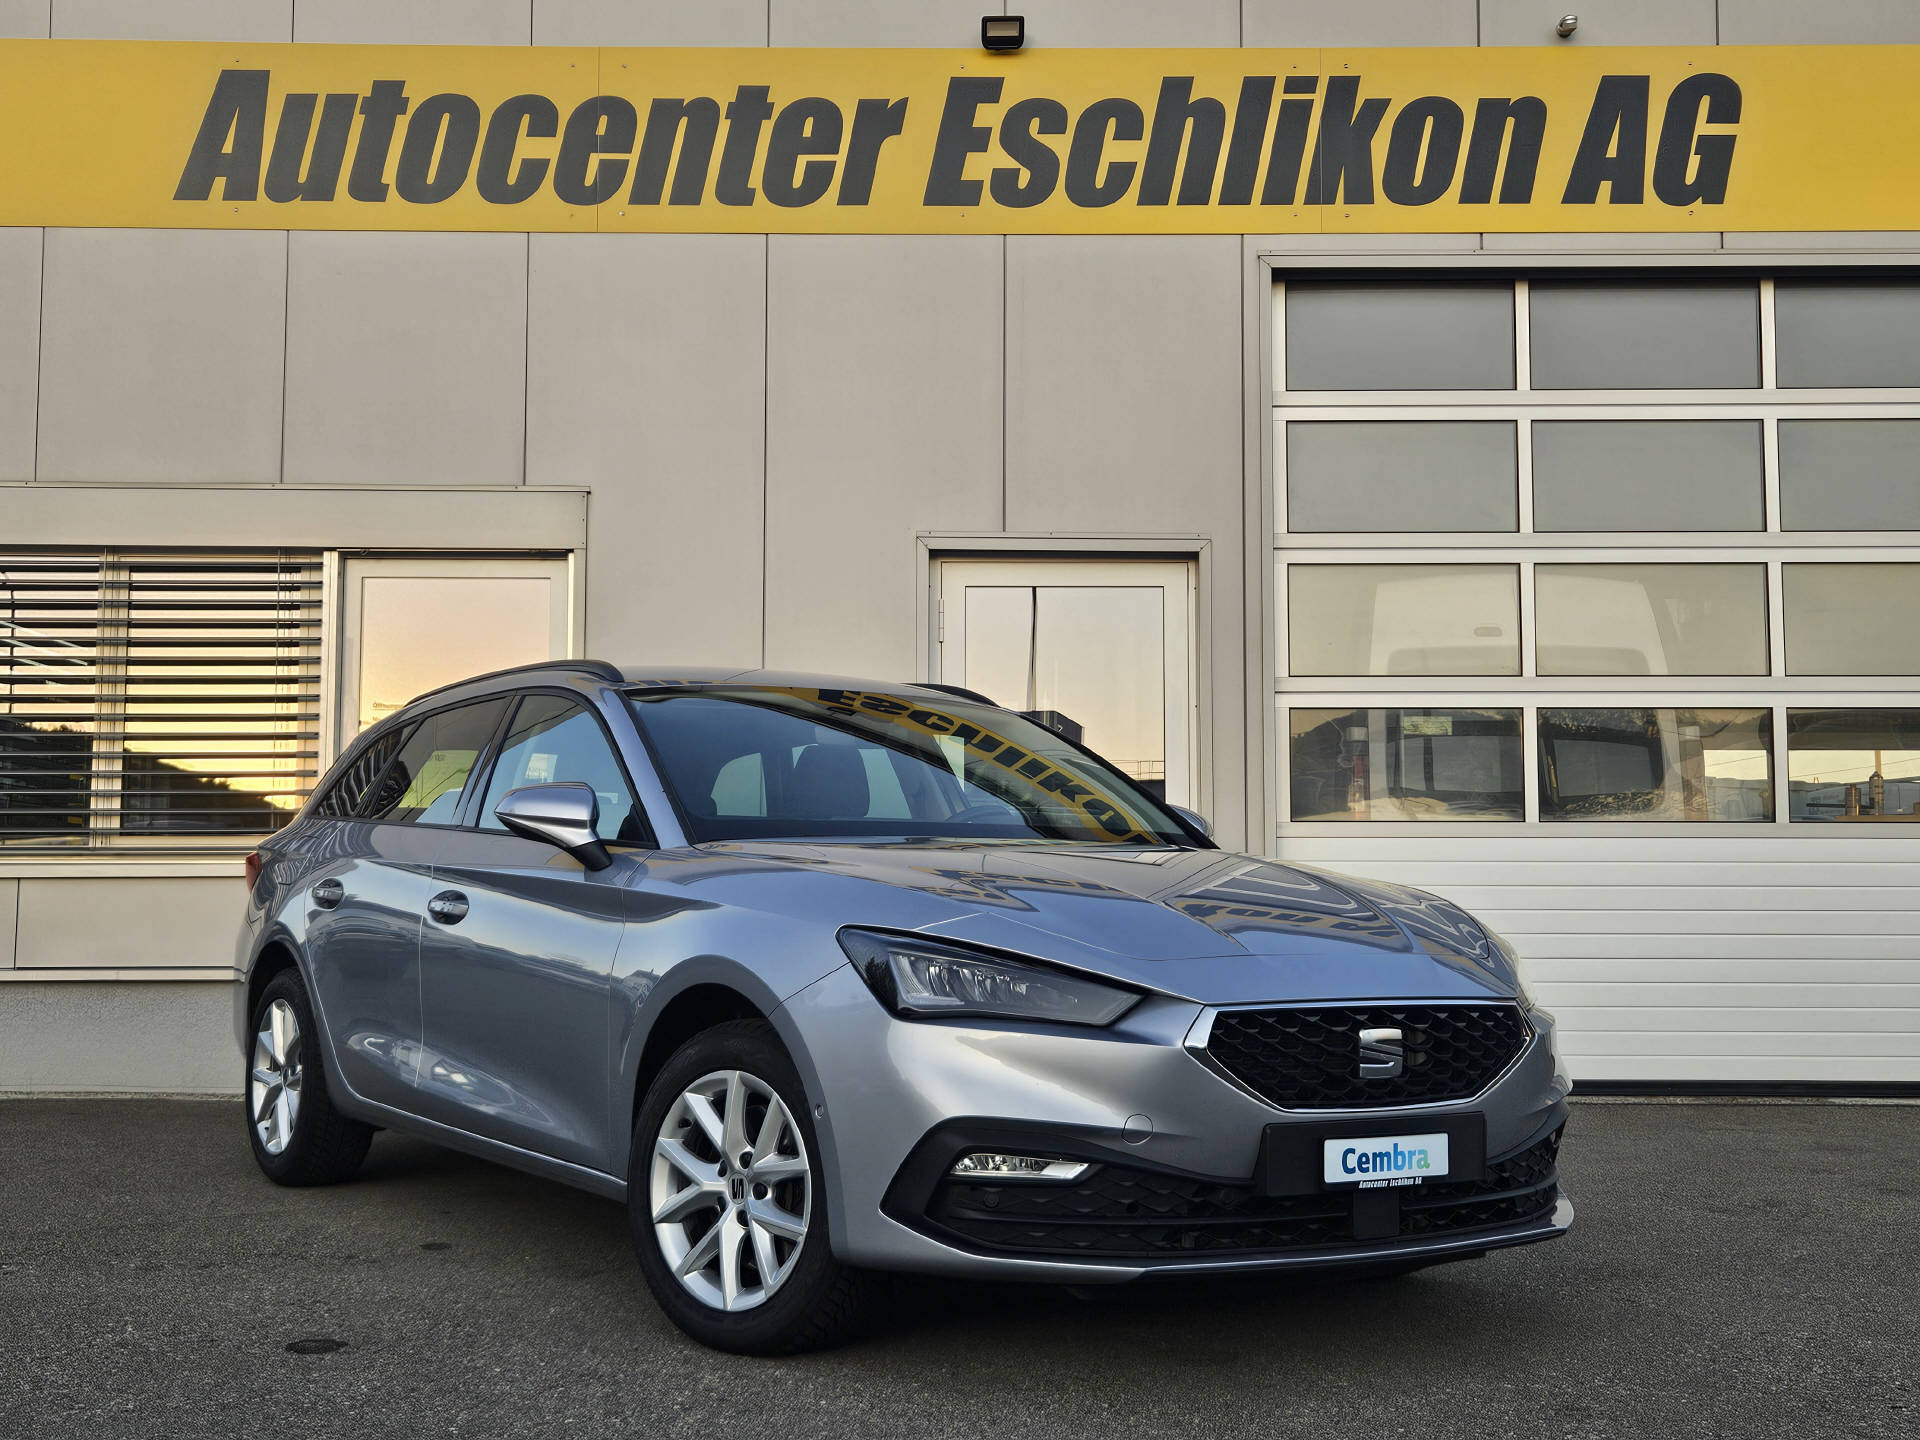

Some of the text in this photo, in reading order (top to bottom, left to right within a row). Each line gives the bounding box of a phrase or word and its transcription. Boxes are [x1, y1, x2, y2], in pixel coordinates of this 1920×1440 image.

[173, 69, 1743, 209] Autocenter Eschlikon AG
[1341, 1142, 1431, 1175] Cembra
